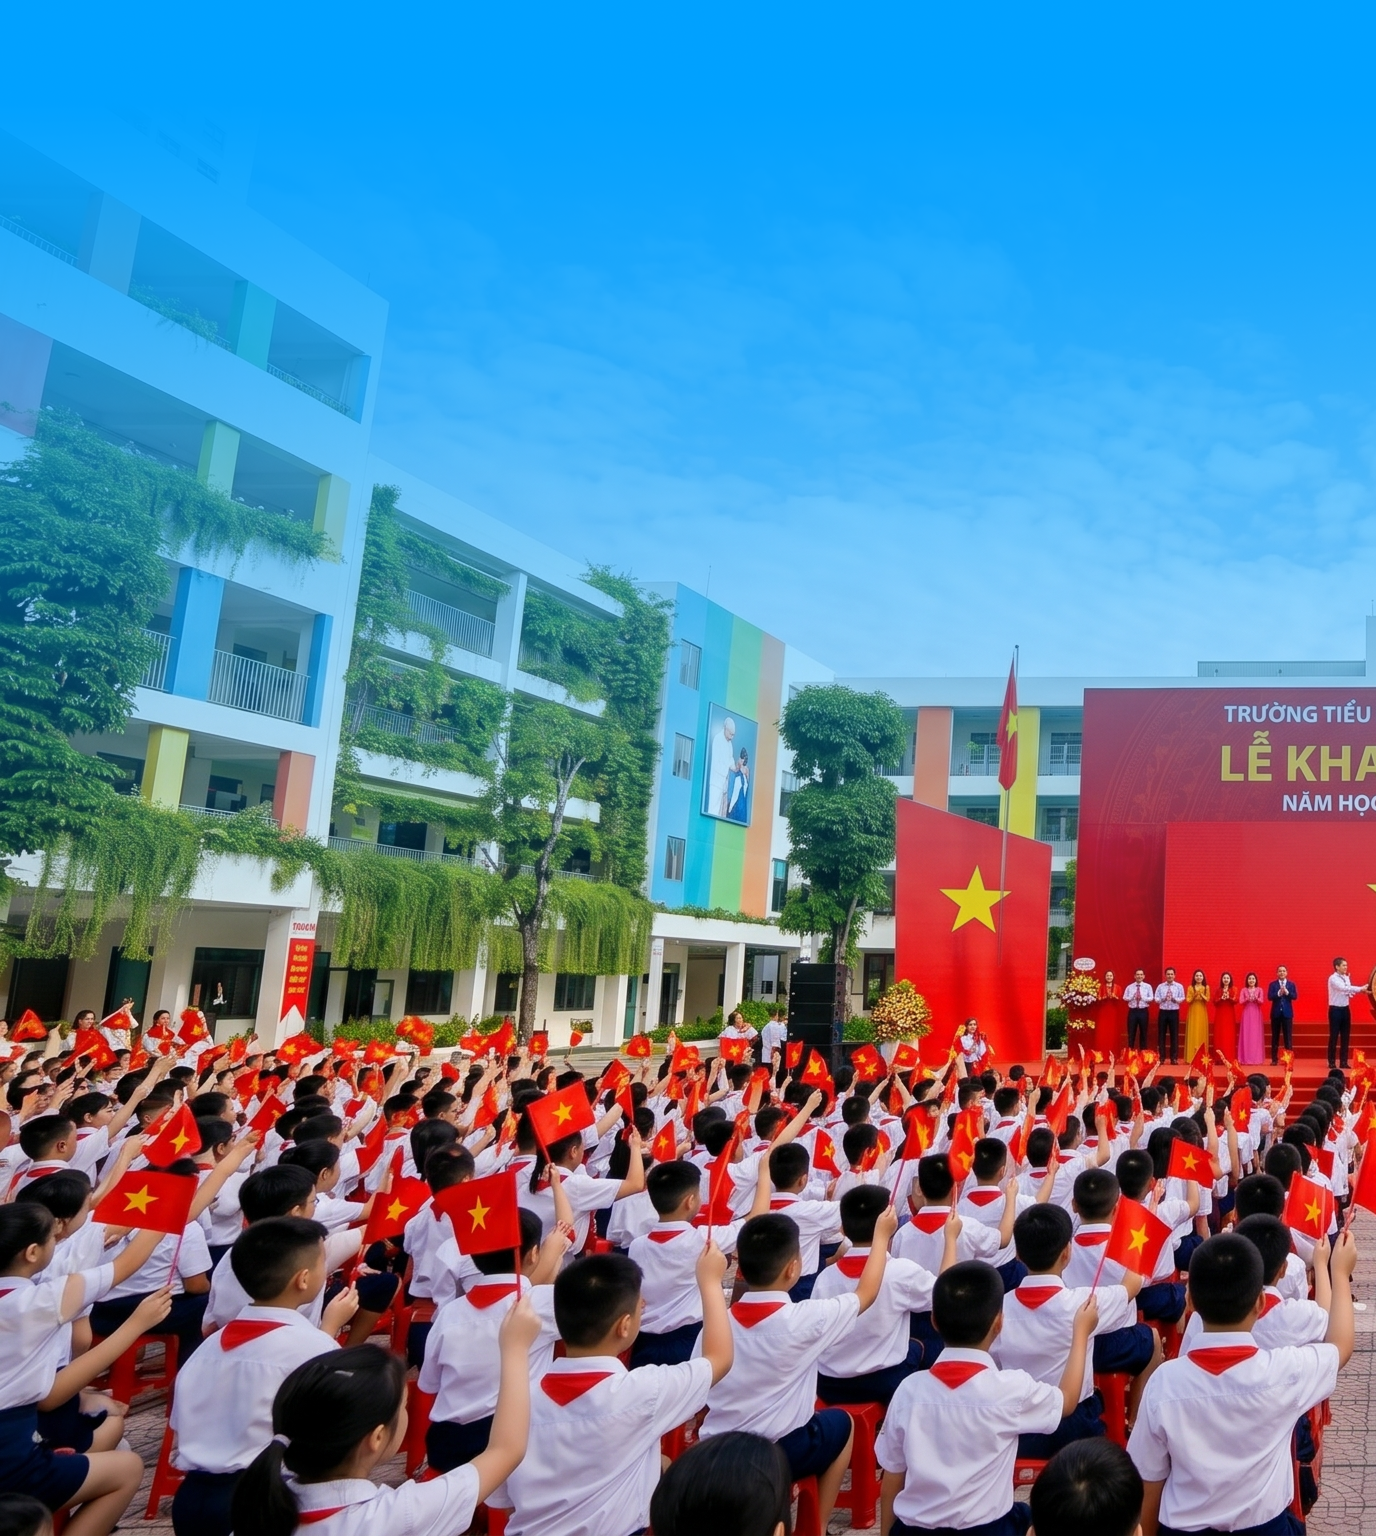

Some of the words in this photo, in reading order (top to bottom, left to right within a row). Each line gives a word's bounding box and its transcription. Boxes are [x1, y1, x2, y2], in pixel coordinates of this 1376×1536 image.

[1223, 701, 1319, 724] TRƯỜNG
[1322, 698, 1371, 724] TIỂU
[1220, 730, 1273, 782] LỄ
[1282, 790, 1333, 812] NĂM
